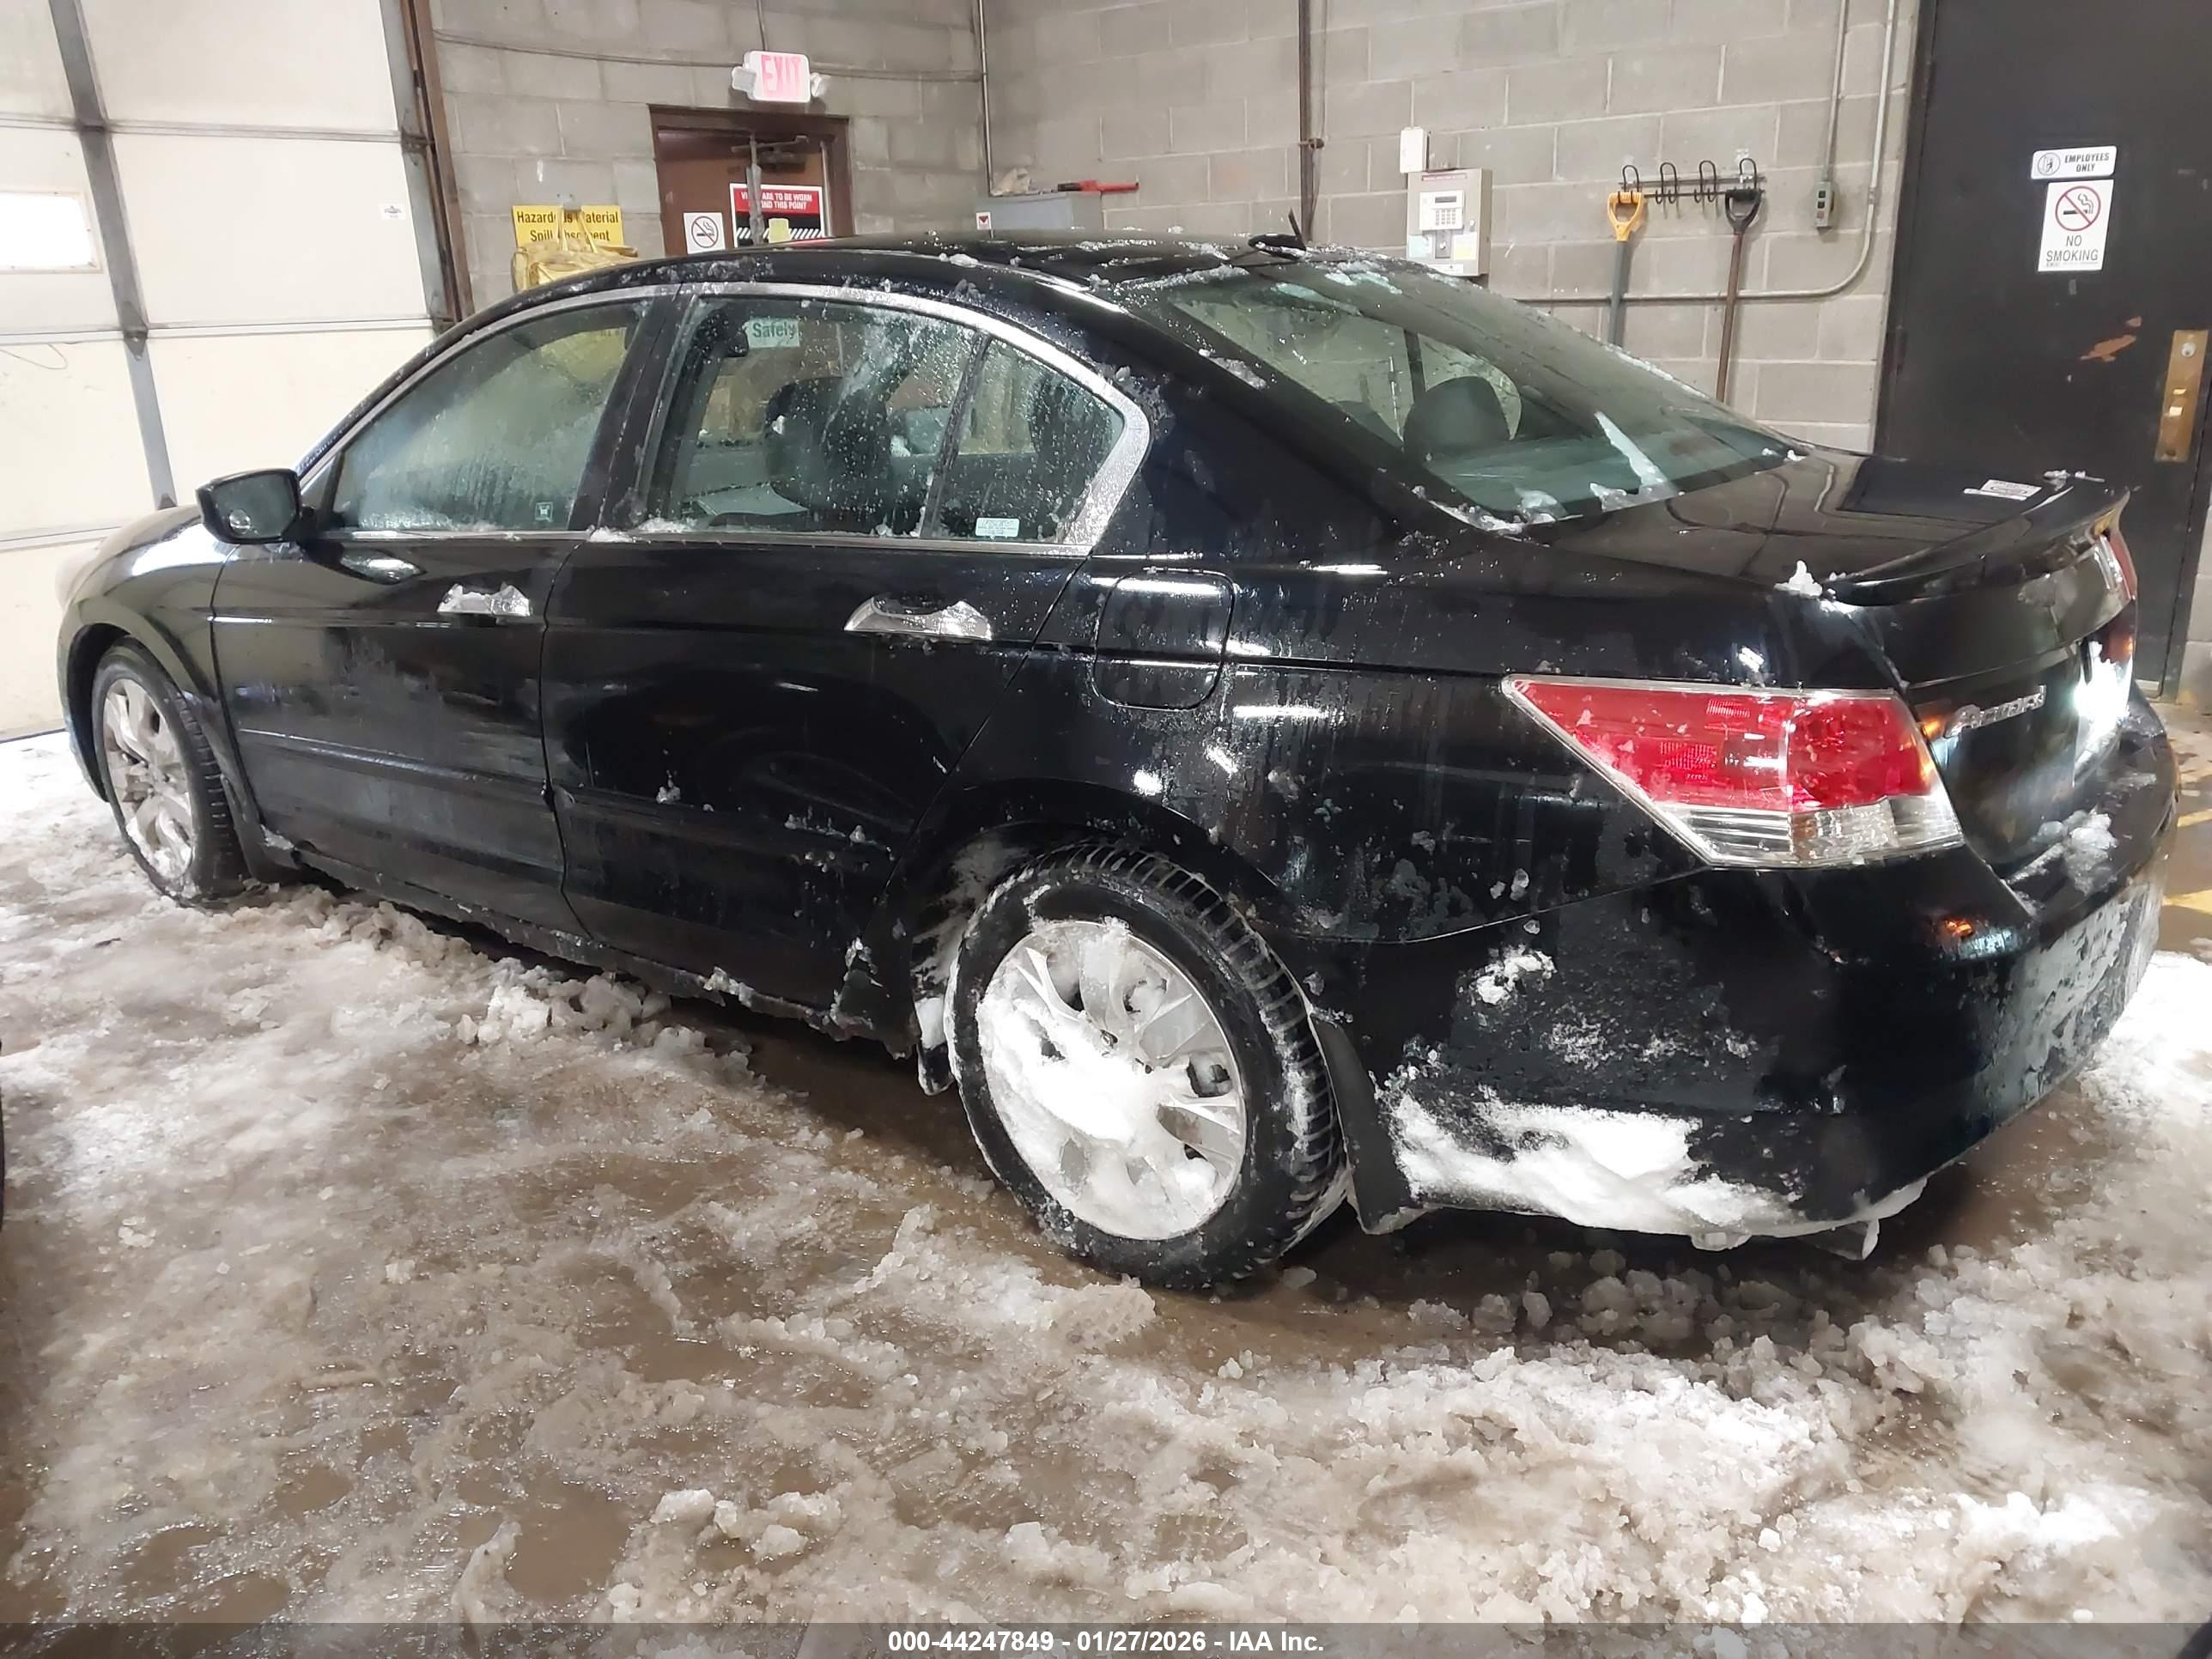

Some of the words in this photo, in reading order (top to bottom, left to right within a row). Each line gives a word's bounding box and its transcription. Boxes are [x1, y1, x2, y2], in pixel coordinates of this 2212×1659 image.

[762, 54, 801, 97] EXIT
[2064, 153, 2109, 163] EMPLOYEES
[762, 192, 774, 201] ARE
[576, 211, 618, 223] aterial
[2066, 234, 2081, 246] NO
[2046, 249, 2099, 262] SMOKING
